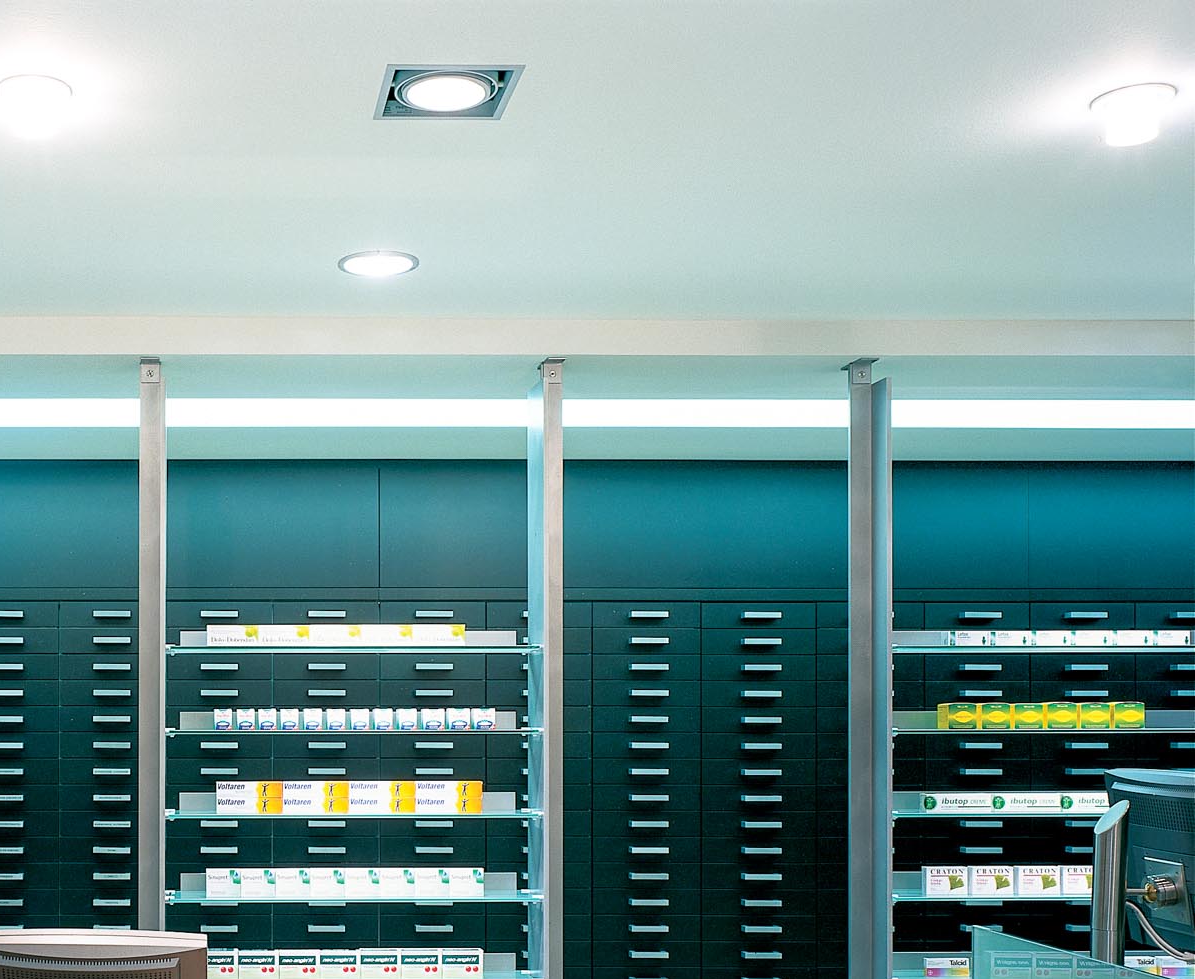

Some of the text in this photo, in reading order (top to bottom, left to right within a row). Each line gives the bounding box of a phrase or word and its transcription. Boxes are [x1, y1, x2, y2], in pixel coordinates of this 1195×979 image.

[941, 797, 968, 806] ibutop
[1010, 797, 1038, 805] ibutop
[1078, 797, 1106, 805] ibutop
